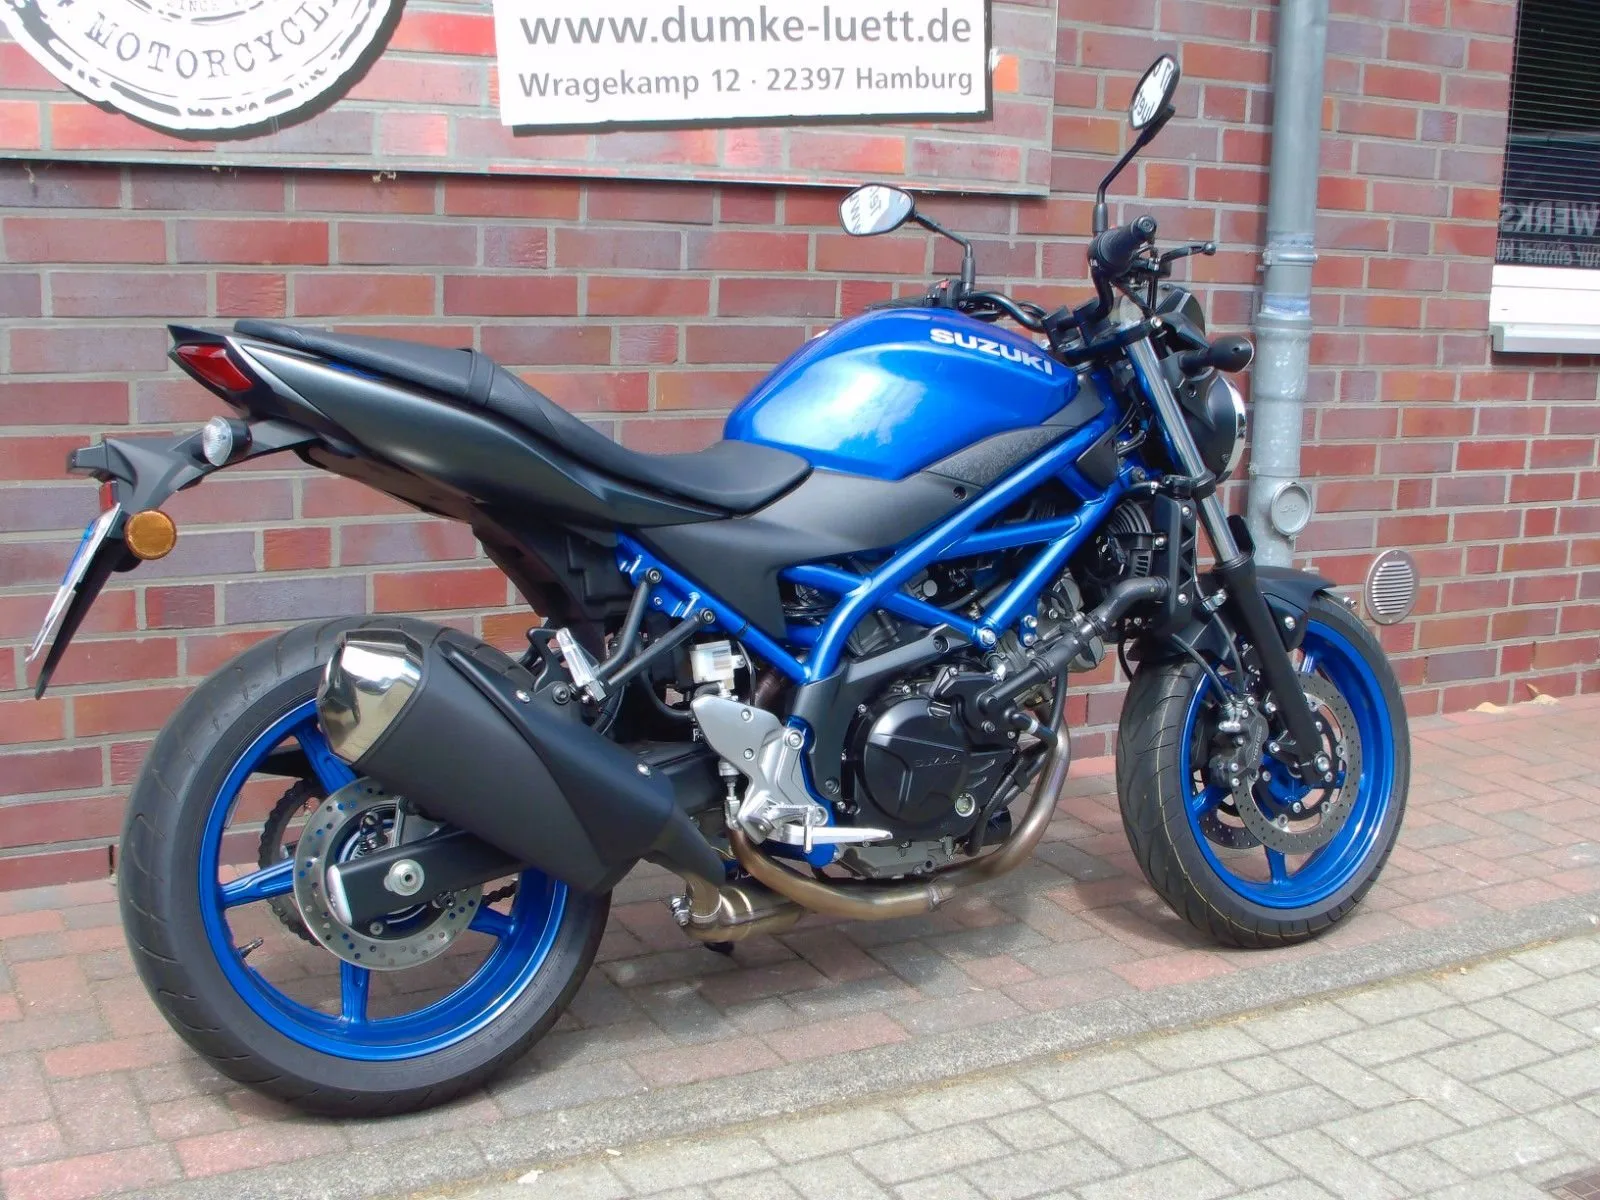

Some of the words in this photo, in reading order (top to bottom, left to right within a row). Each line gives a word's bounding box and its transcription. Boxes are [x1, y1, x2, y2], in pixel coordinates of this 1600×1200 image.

[84, 0, 338, 80] MOTORCYCL
[519, 5, 972, 44] www.dumke-luett.de
[518, 70, 699, 102] Wragekamp
[711, 69, 741, 92] 12
[766, 67, 844, 91] 22397
[856, 65, 973, 95] Hamburg
[930, 327, 1053, 376] SUZUKI
